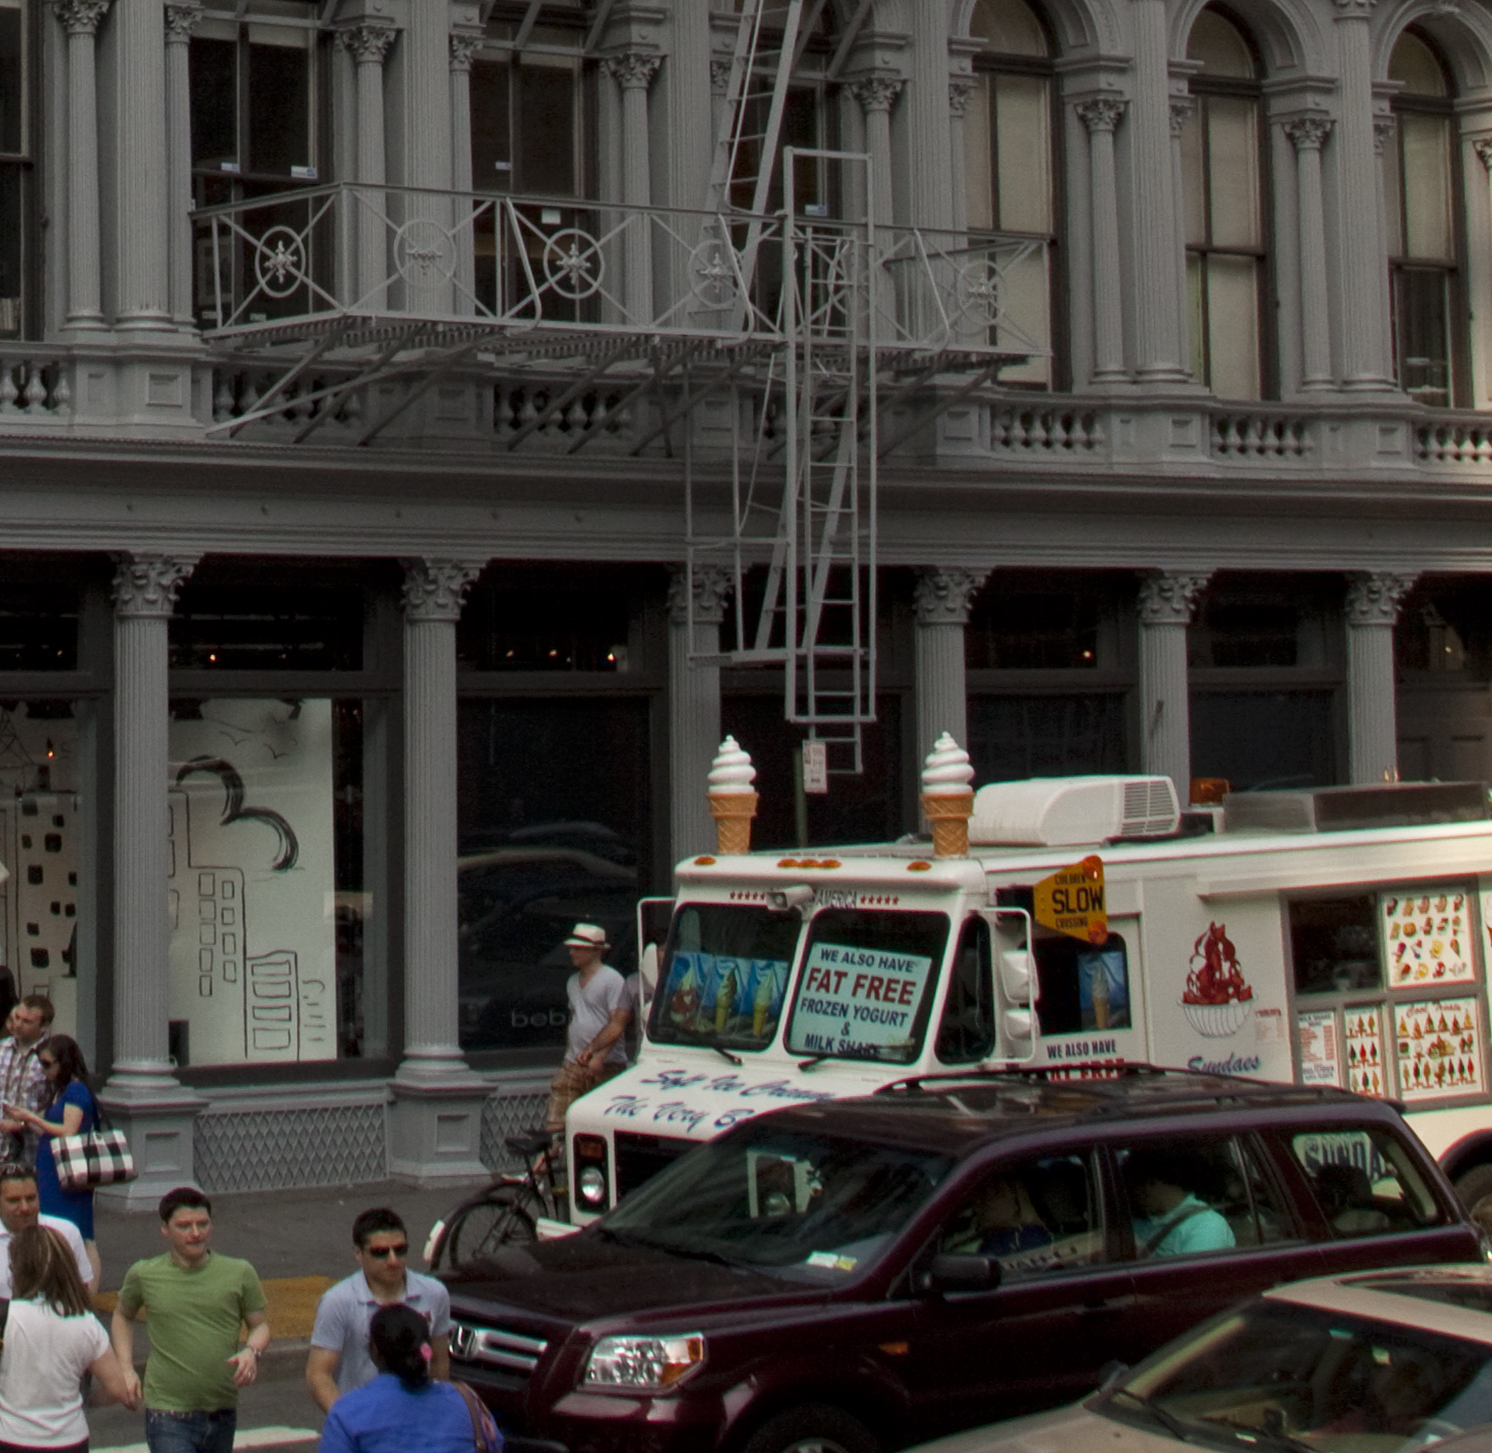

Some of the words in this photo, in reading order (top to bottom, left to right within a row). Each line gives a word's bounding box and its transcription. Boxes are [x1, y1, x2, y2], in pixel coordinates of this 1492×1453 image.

[1051, 886, 1104, 914] SLOW
[820, 948, 839, 963] WE
[841, 952, 875, 967] ALSO
[878, 956, 915, 973] HAVE
[806, 967, 848, 995] FAT
[851, 973, 917, 1006] FREE
[800, 997, 849, 1018] FROZEN
[852, 1005, 909, 1028] YOGURT
[841, 1022, 851, 1036] &
[804, 1034, 835, 1051] MILK
[1047, 1045, 1063, 1060] WE
[1065, 1042, 1090, 1058] ALSO
[1091, 1039, 1117, 1054] HAVE
[1187, 1051, 1261, 1075] Sundaes
[604, 1095, 651, 1118] The
[653, 1101, 711, 1134] Very
